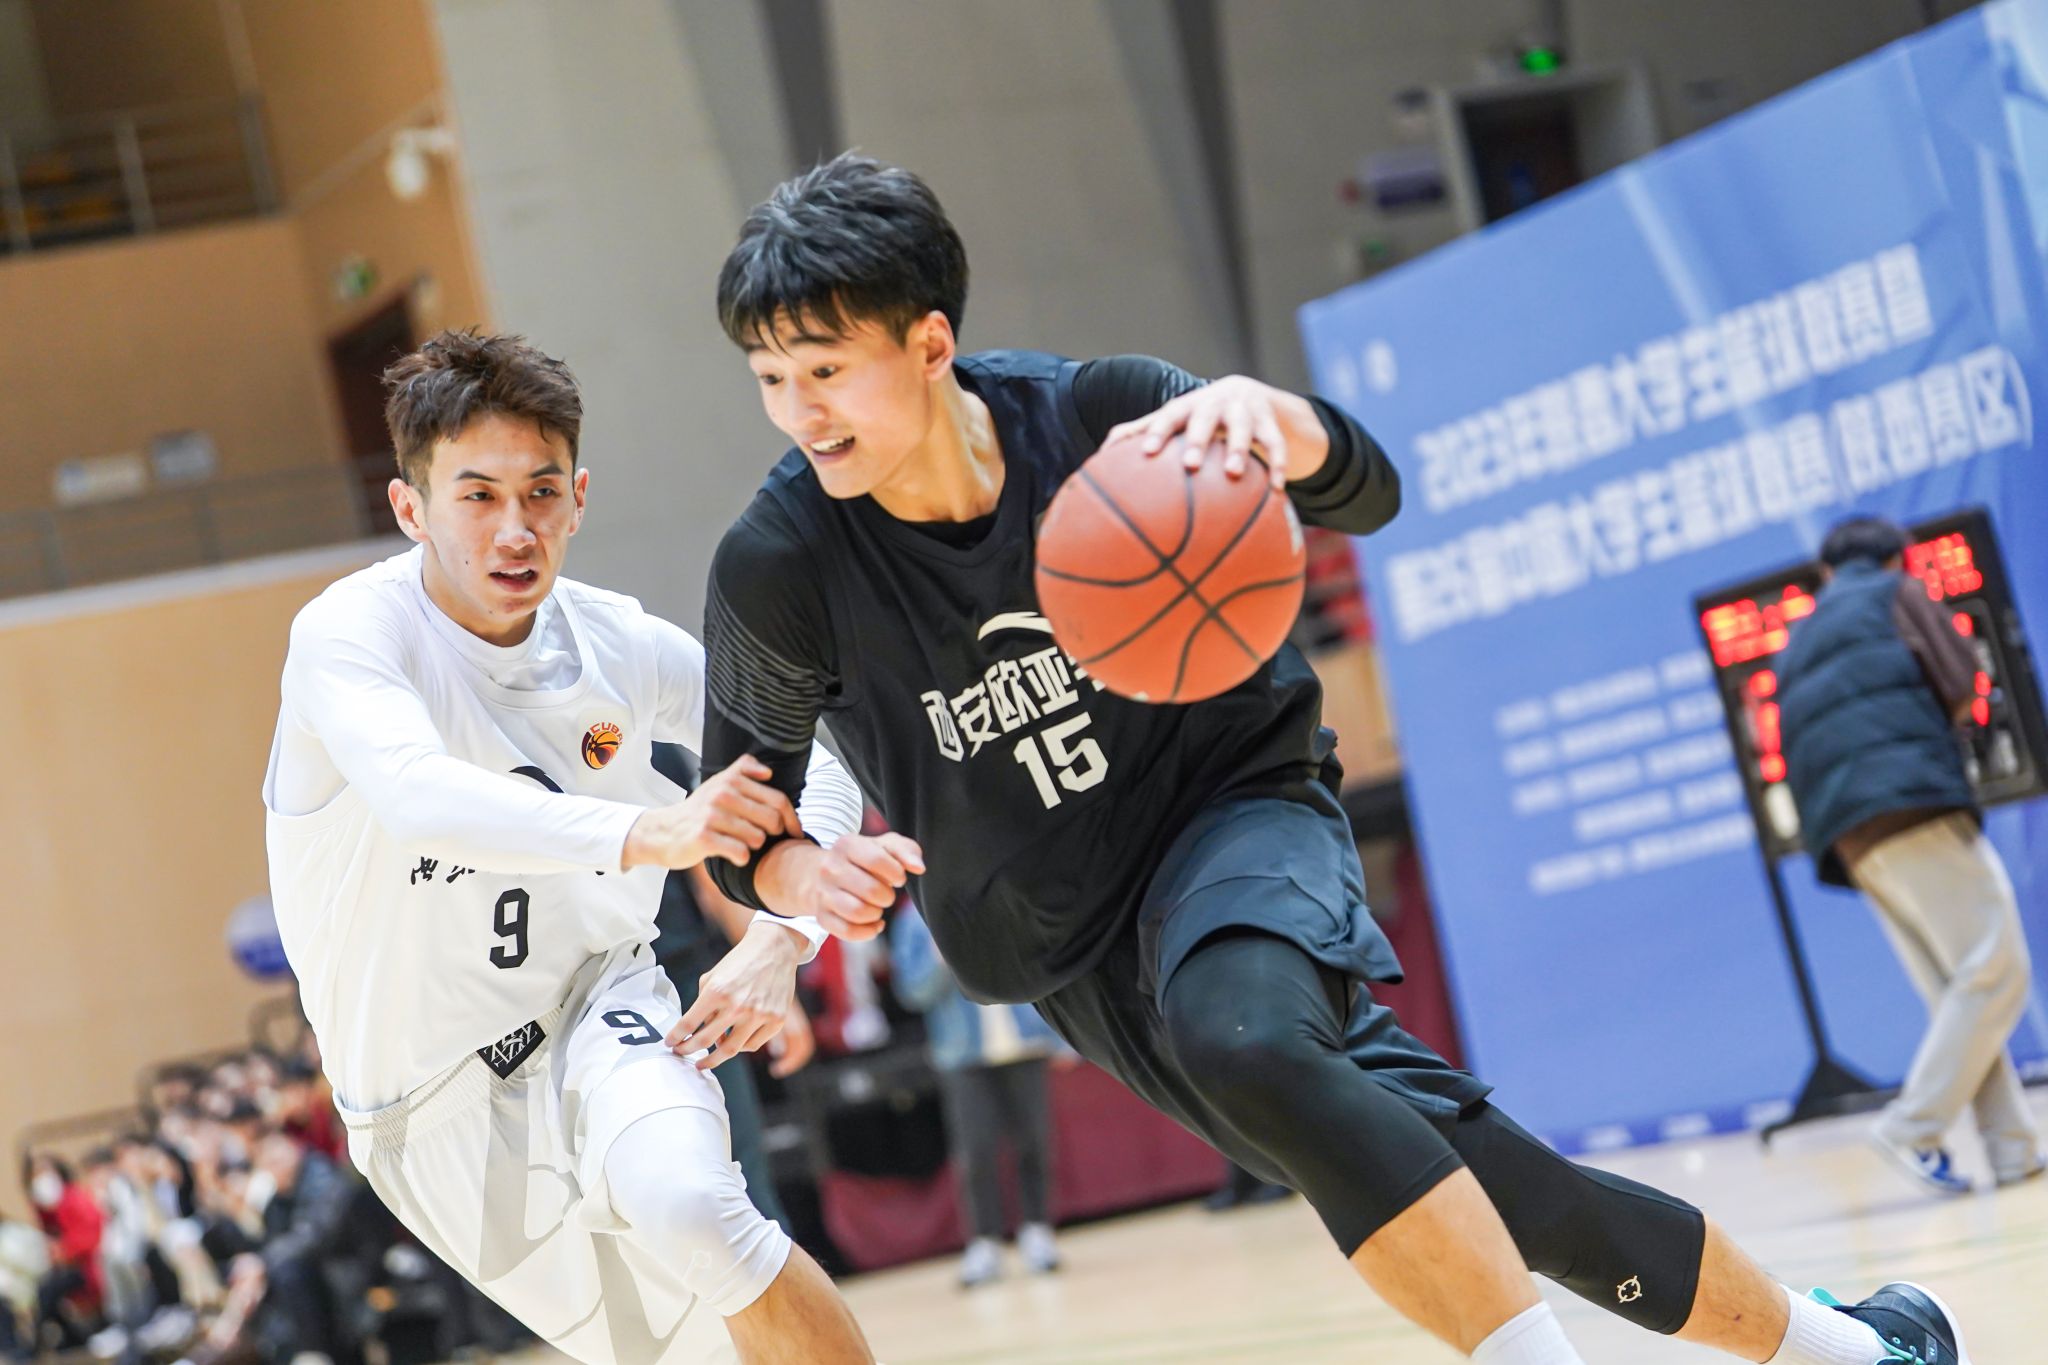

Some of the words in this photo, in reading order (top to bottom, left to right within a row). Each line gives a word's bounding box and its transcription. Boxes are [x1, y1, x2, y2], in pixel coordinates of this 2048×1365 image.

[919, 645, 1106, 763] 西安欧亚
[1012, 711, 1110, 810] 15
[489, 887, 530, 970] 9
[600, 1009, 664, 1046] 9
